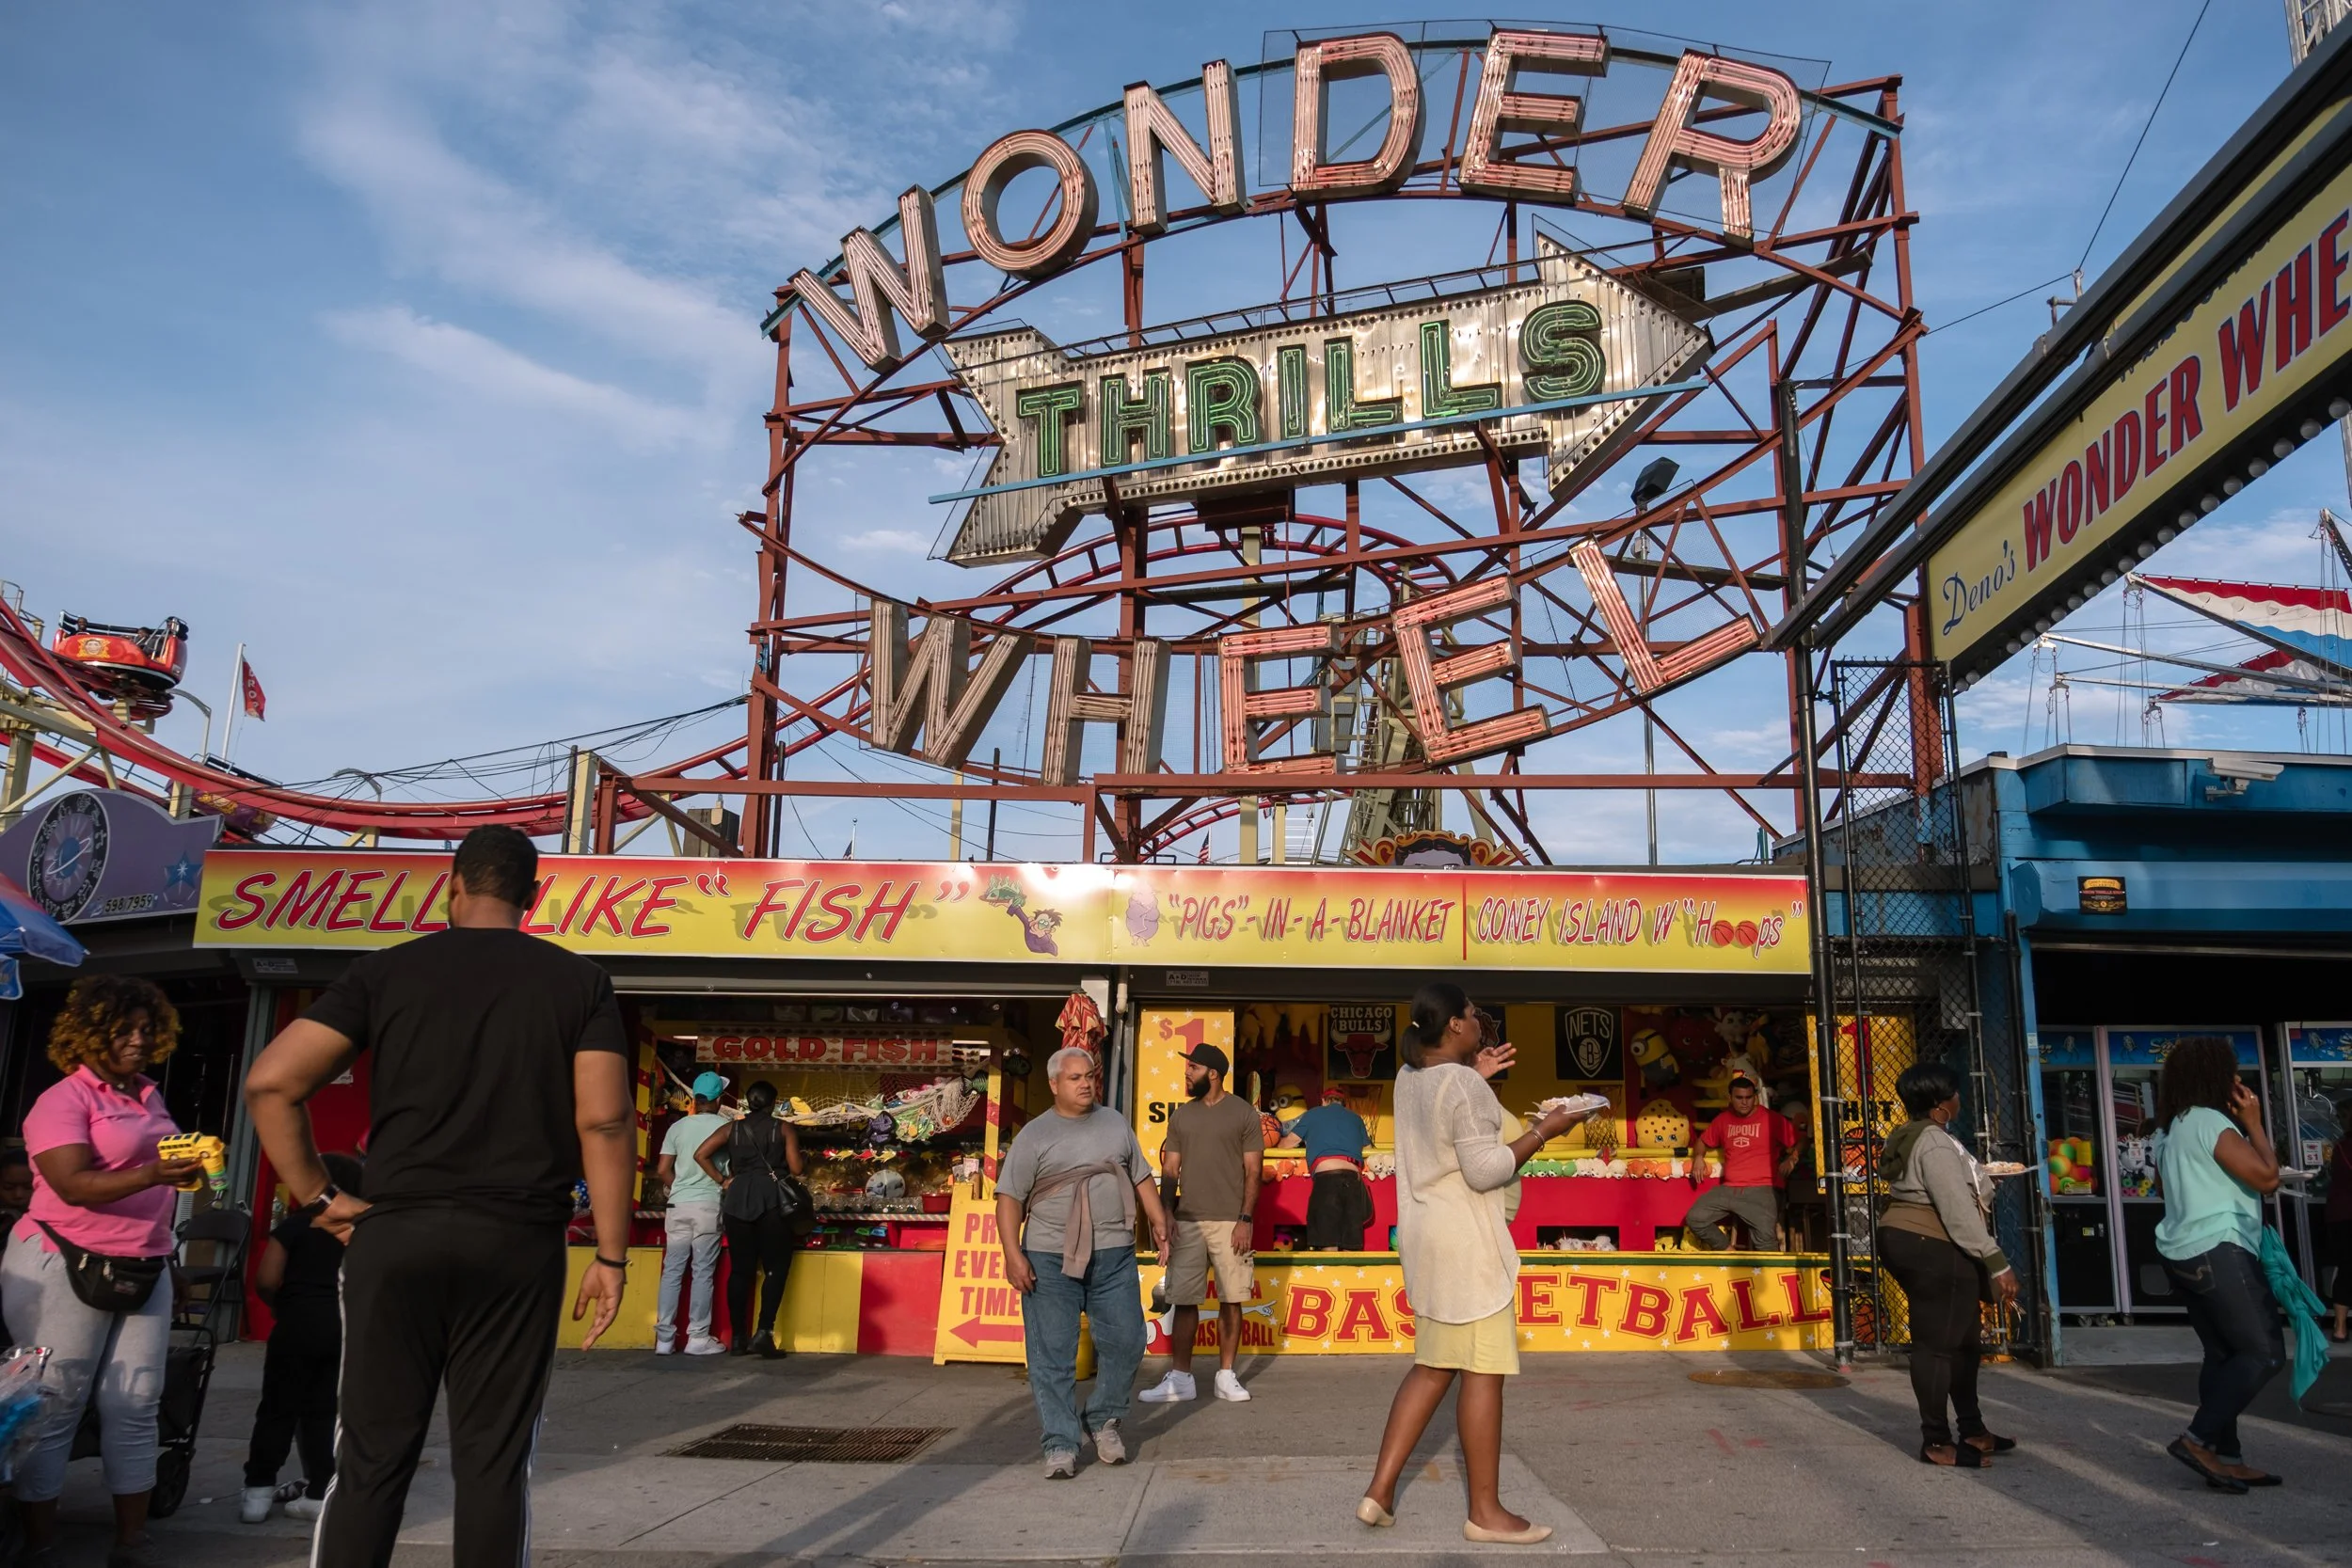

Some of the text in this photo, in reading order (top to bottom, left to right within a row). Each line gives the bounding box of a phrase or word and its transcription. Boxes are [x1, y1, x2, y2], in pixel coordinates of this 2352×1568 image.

[791, 26, 1804, 374] WONDER
[1016, 298, 1607, 479] THRILLS
[1942, 208, 2352, 637] Deno's WONDER WHE
[868, 534, 1766, 788] WHEEL
[215, 869, 452, 935] SMELL
[519, 871, 691, 939] LIKE
[1476, 895, 1550, 944] CONEY
[1558, 897, 1644, 946] ISLAND
[1652, 900, 1679, 942] W
[1330, 1006, 1392, 1019] CHICAGO
[1339, 1019, 1383, 1032] BULLS
[1568, 1011, 1611, 1039] NETS
[712, 1036, 938, 1062] GOLD FISH
[1727, 1123, 1761, 1138] TAPOUT
[954, 1249, 1008, 1280] EVE
[960, 1286, 1020, 1317] TIME
[1279, 1272, 1833, 1344] BAETBALL
[1193, 1319, 1275, 1347] ASBALL
